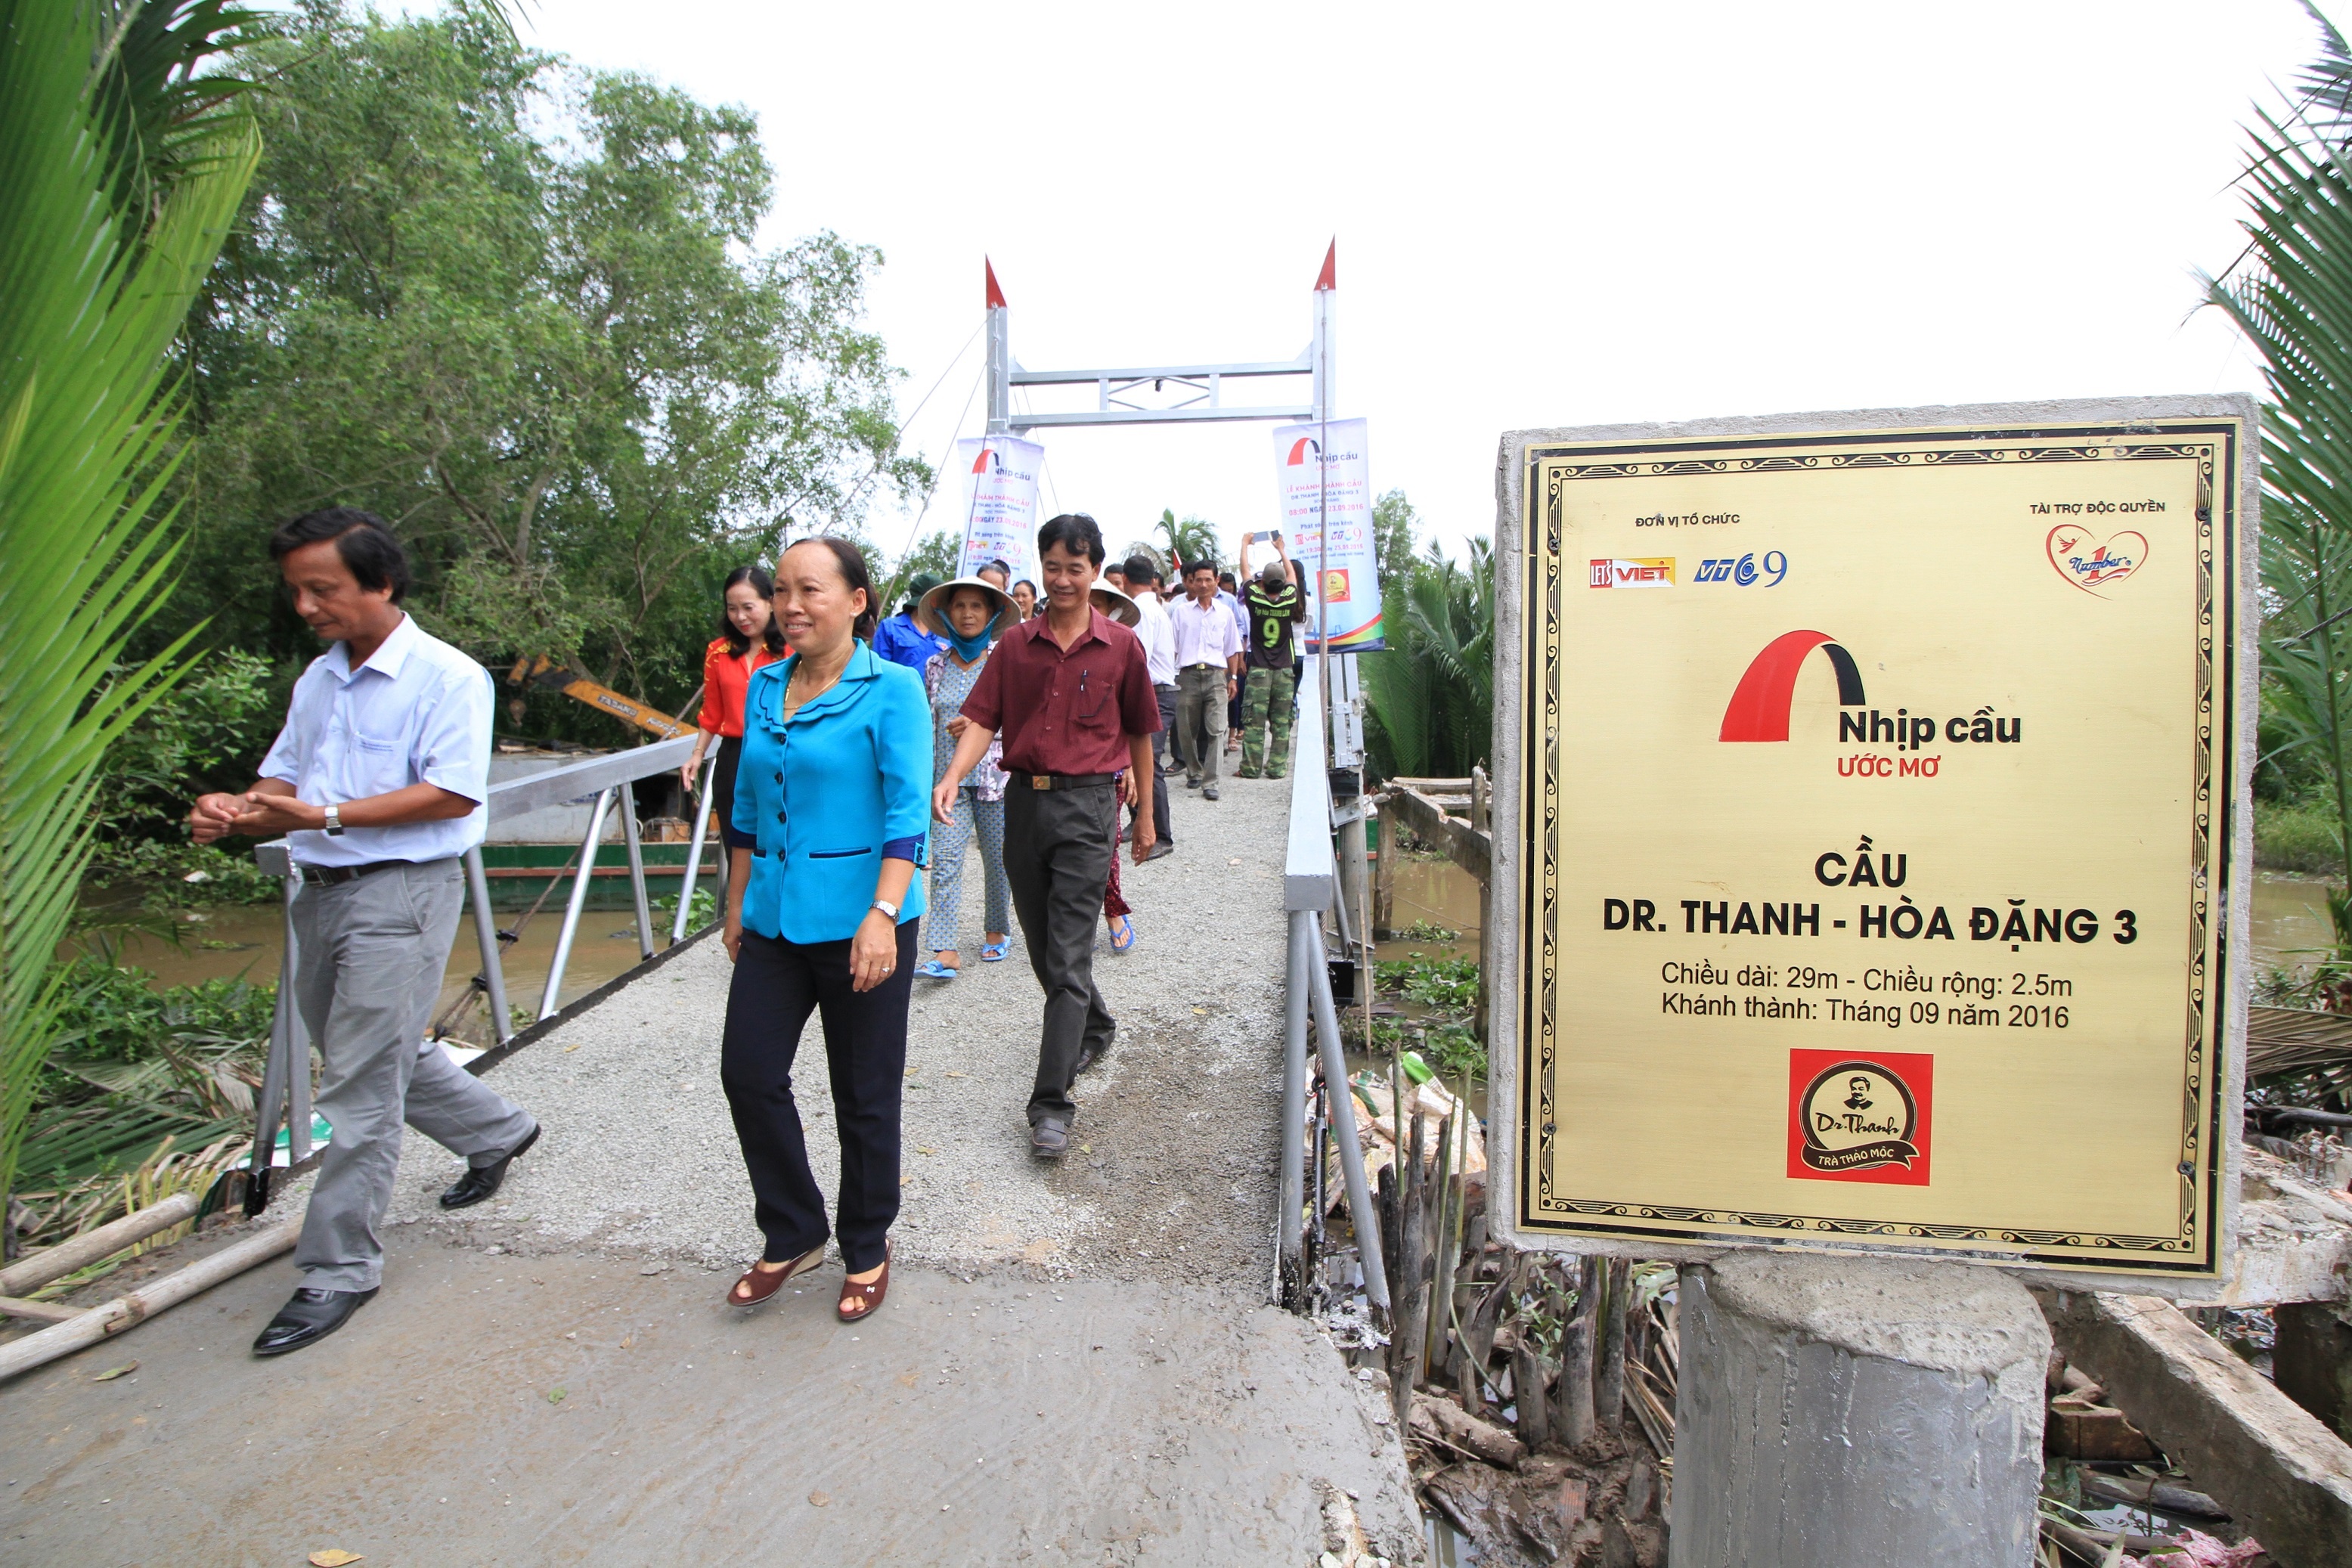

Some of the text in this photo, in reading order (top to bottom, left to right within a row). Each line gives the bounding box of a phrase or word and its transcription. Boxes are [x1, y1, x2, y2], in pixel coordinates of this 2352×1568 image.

[1295, 482, 1320, 492] KHÁNH
[1325, 481, 1345, 489] HÀNH
[1328, 504, 1364, 512] 23.09.2016
[1635, 512, 1740, 528] ĐƠN VỊ TỔ CHỨC
[2030, 499, 2166, 516] TÀI TRỢ ĐỘC QUYỀN
[1615, 560, 1671, 582] VIET
[2068, 550, 2128, 575] Number
[1263, 617, 1280, 648] 9
[1839, 705, 2021, 751] Nhịp cầu
[1837, 752, 1941, 778] ƯỚC MƠ
[1814, 834, 1907, 888] CẦU
[1603, 898, 1667, 934] DR.
[1681, 900, 1820, 937] THANH
[1859, 895, 1955, 941] HÒA
[1969, 899, 2098, 953] ĐẶNG
[2113, 910, 2138, 945] 3
[1661, 962, 1729, 986] Chiều
[1736, 964, 1779, 989] dài:
[1786, 966, 1838, 990] 29m
[1863, 965, 1935, 993] Chiều
[1941, 970, 2003, 1002] rộng:
[2011, 973, 2073, 997] 2.5m
[1662, 993, 2069, 1029] Khánh thành: Tháng 09 năm 2016
[1818, 1145, 1895, 1166] TRÀ THẢO MỘC
